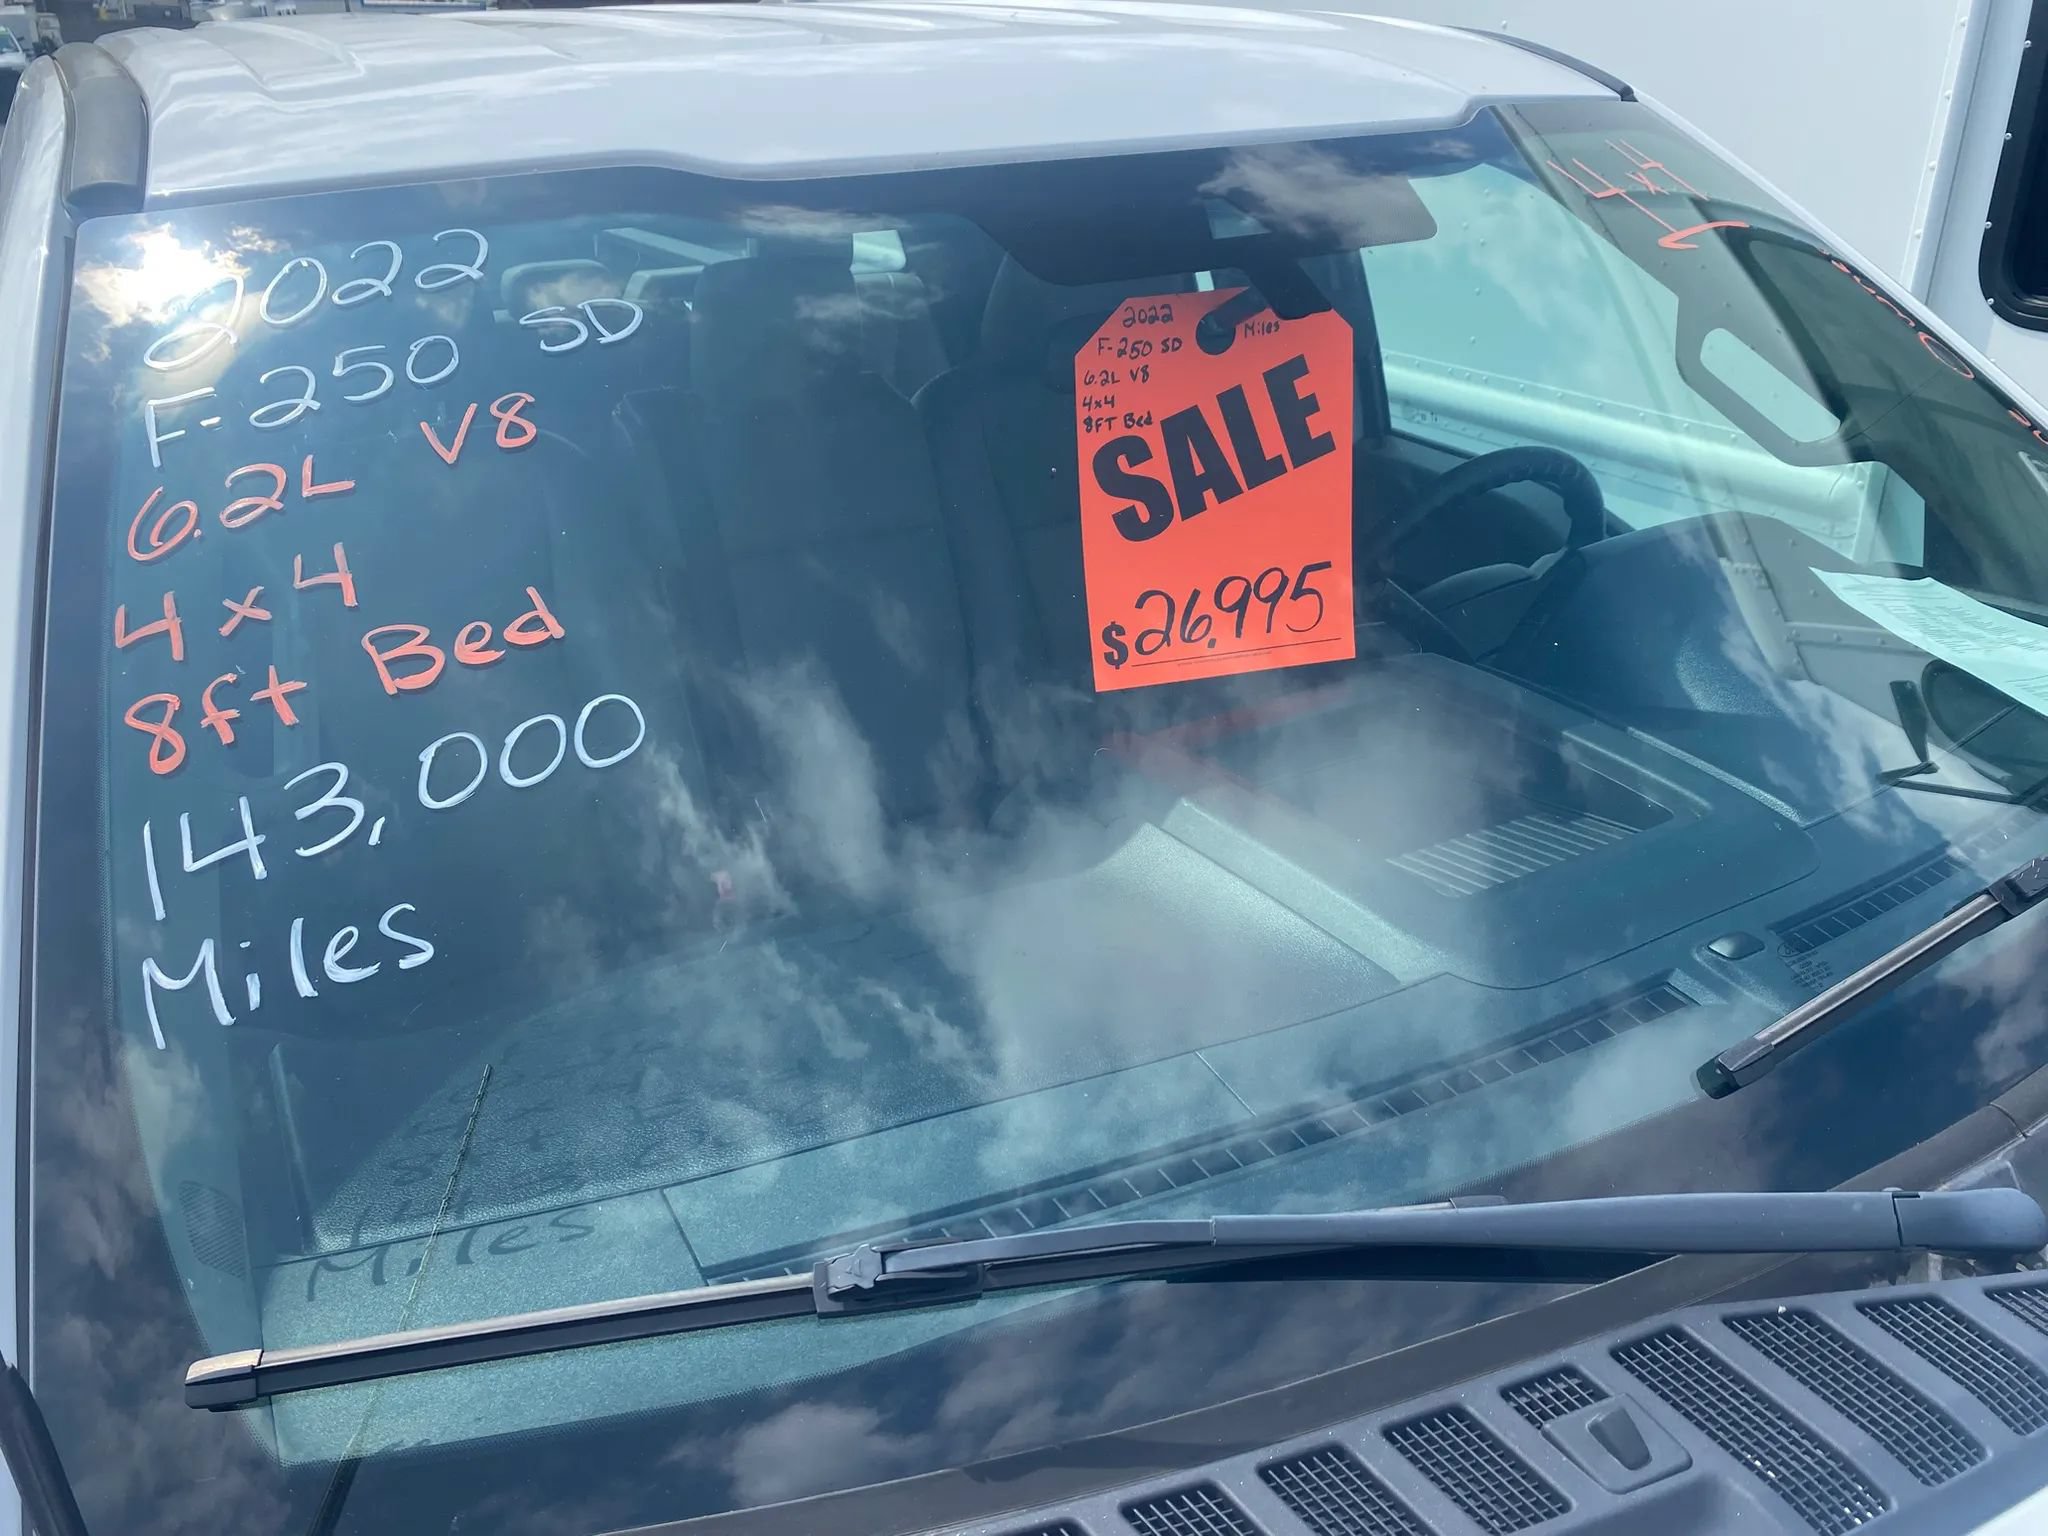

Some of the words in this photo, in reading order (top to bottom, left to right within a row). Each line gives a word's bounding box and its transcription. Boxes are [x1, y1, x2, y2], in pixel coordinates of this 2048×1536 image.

[143, 228, 489, 371] 2022
[1098, 337, 1153, 360] F-250
[1161, 336, 1183, 353] SD
[1123, 303, 1174, 327] 2022
[1243, 320, 1280, 338] Miles
[144, 334, 460, 468] F-250
[519, 298, 644, 353] SD
[1083, 370, 1120, 386] 6.2L
[1130, 364, 1150, 384] V8
[1083, 417, 1117, 434] 8FT
[1124, 412, 1153, 429] Bed
[1092, 353, 1336, 542] SALE
[127, 454, 356, 562] 6.2L
[419, 392, 538, 464] V8
[124, 664, 308, 776] 8ft
[361, 586, 566, 696] Bed
[143, 693, 647, 922] 143,000
[142, 903, 435, 1050] Miles
